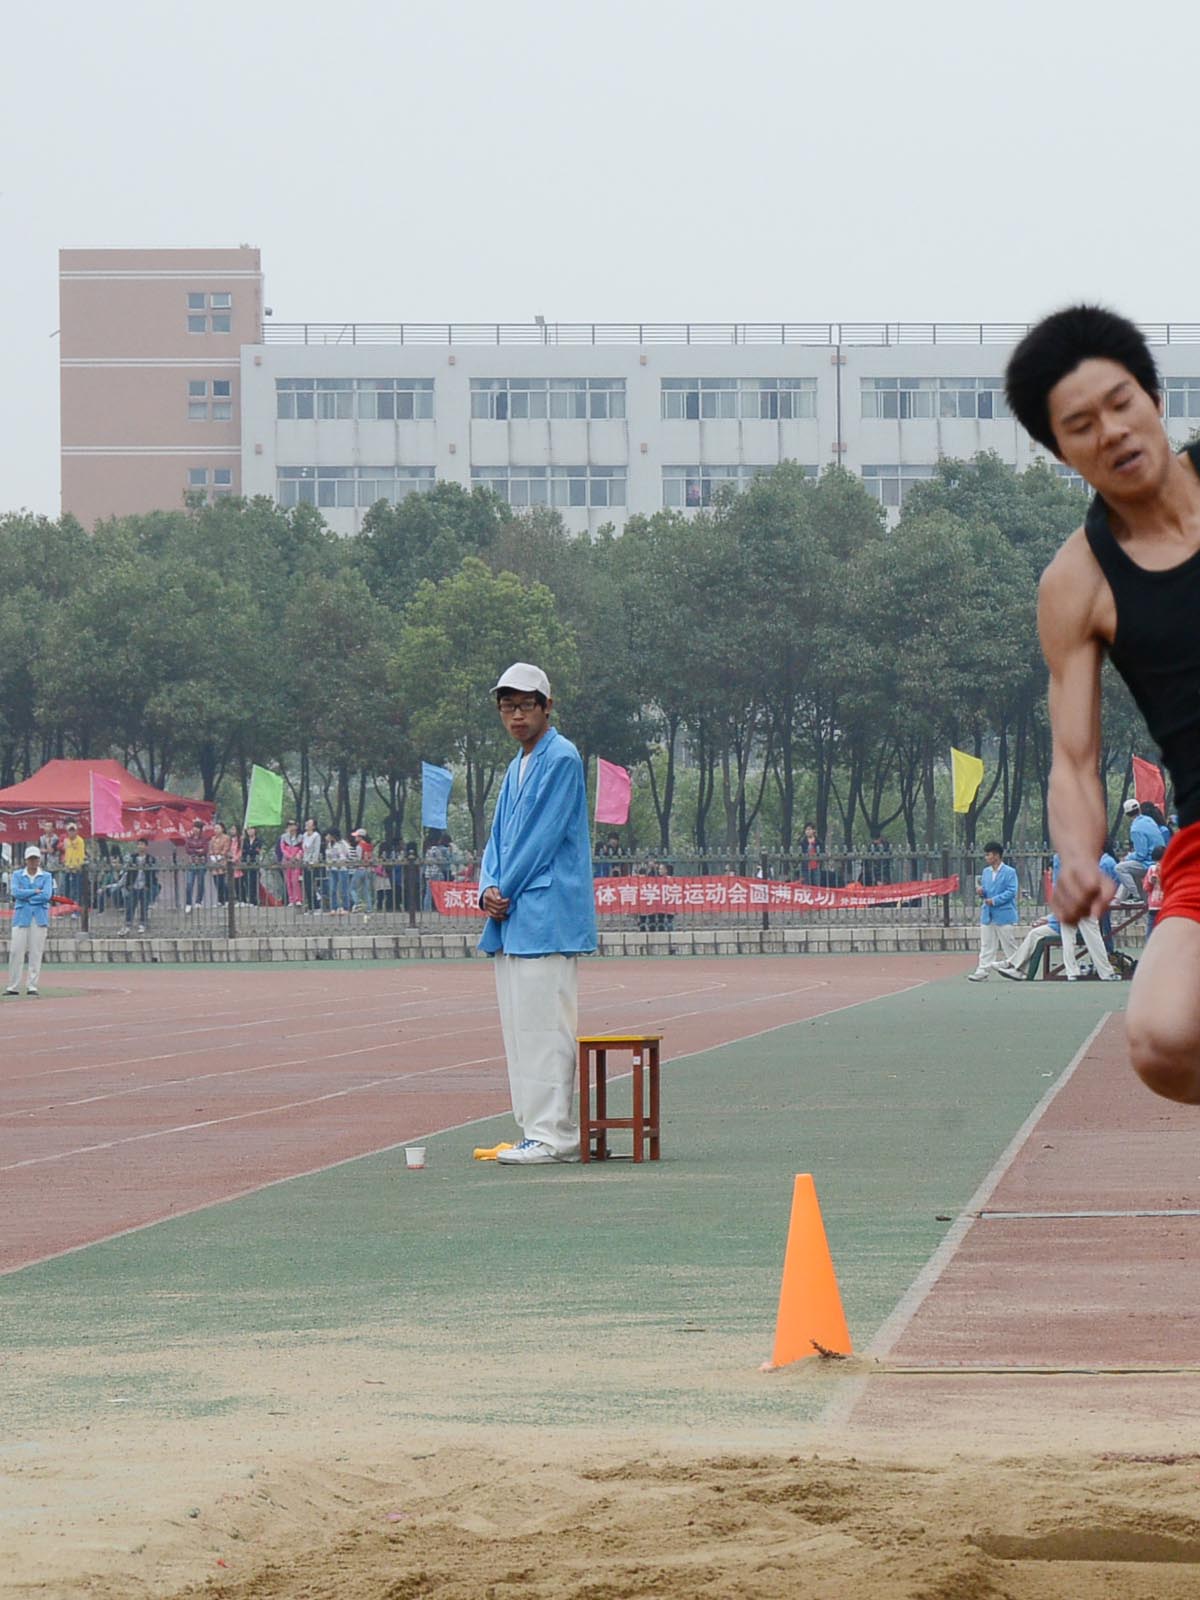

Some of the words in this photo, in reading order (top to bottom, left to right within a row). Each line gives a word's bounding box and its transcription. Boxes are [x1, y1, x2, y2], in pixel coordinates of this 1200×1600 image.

[596, 882, 836, 906] 体育学院运动会圆满成功
